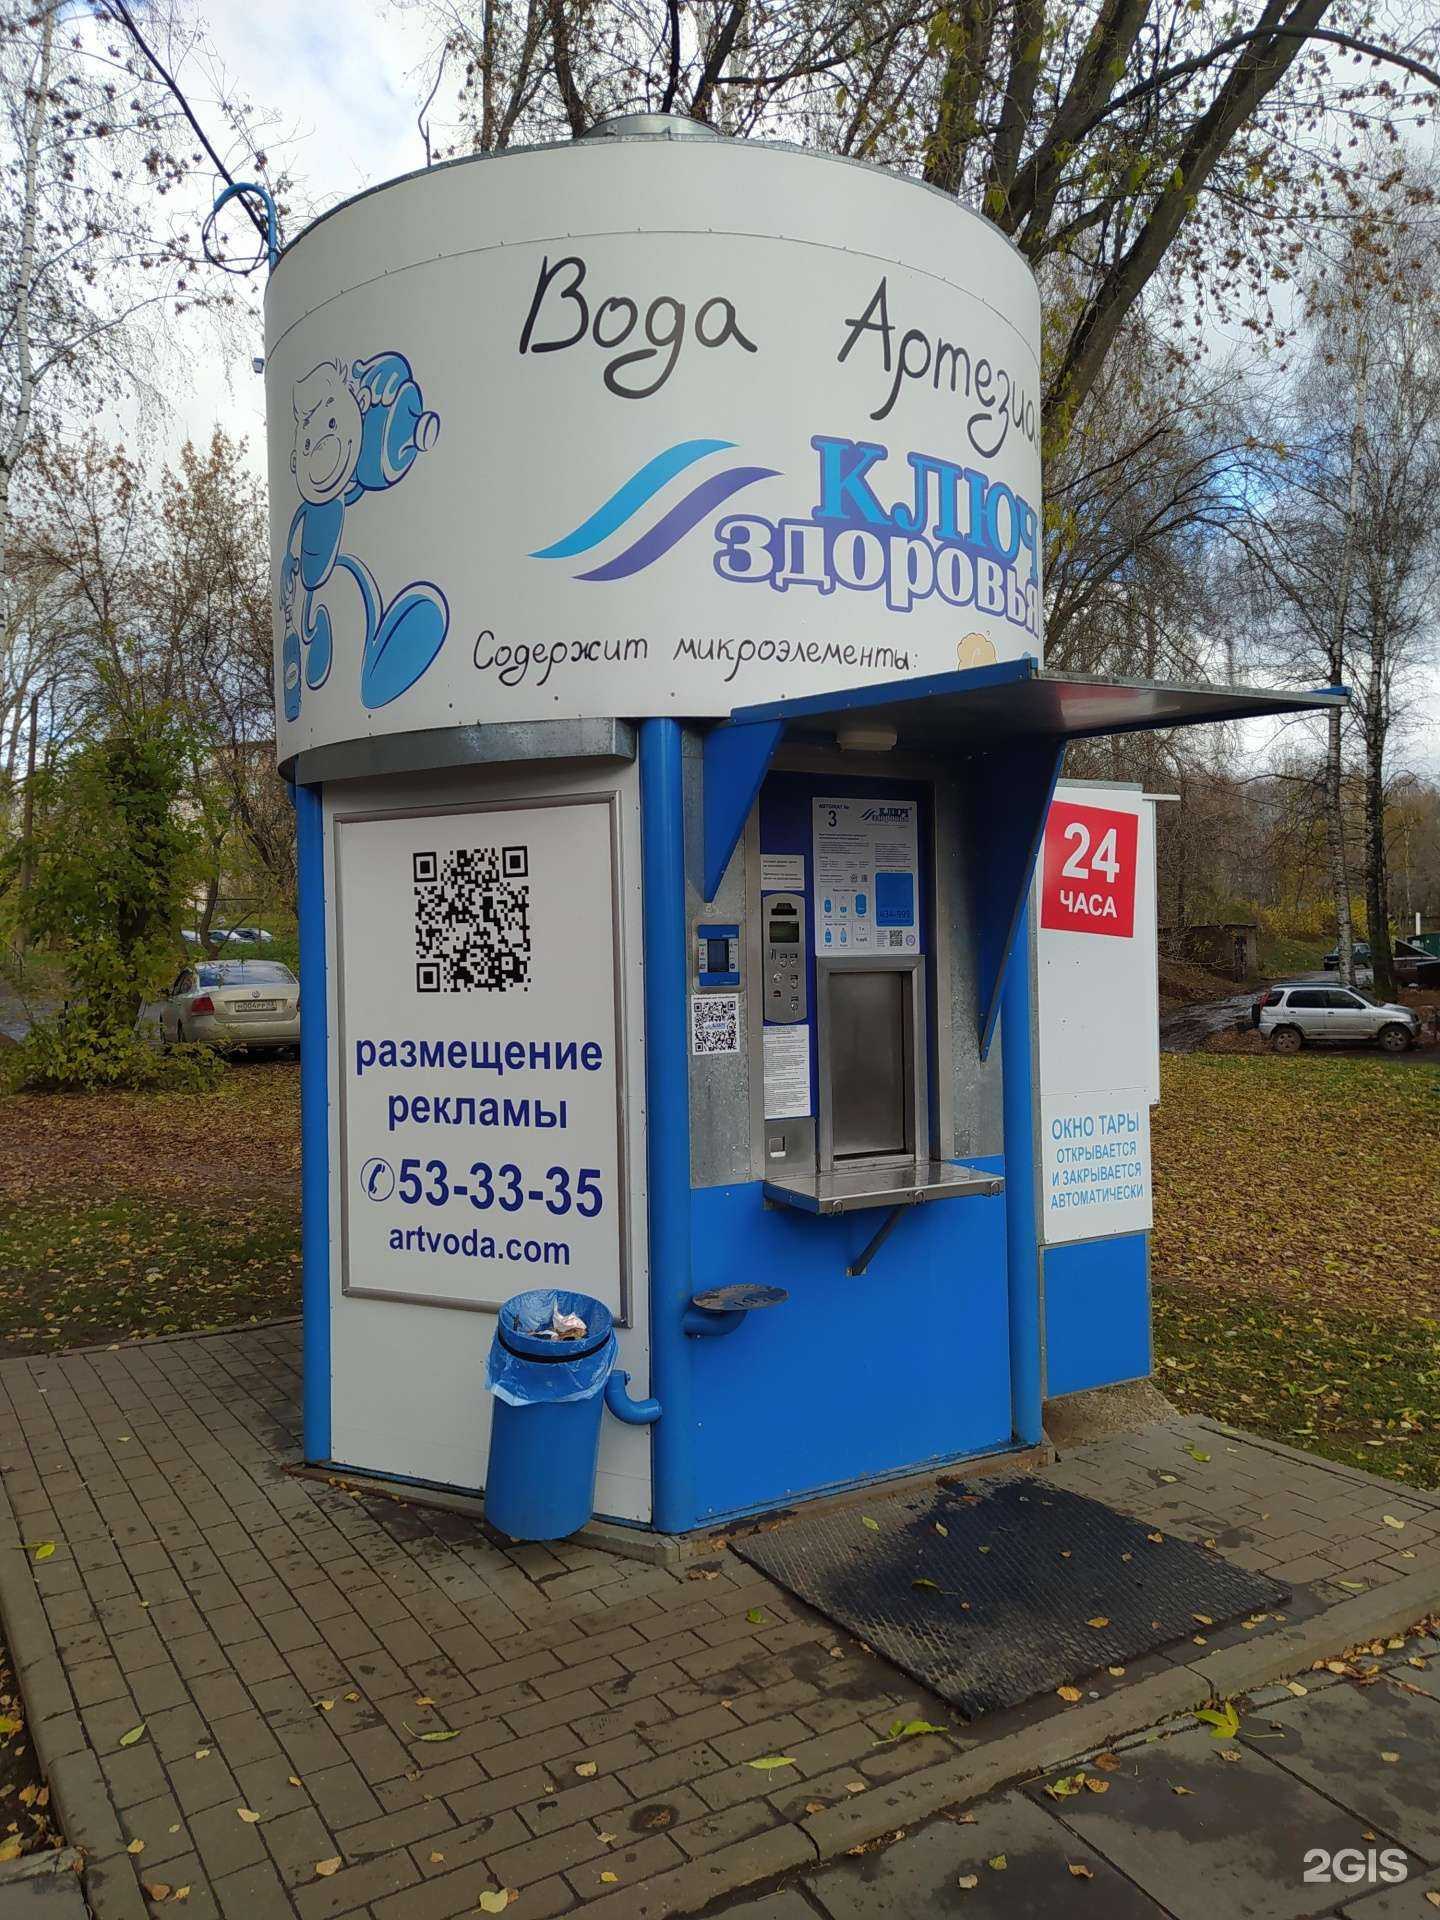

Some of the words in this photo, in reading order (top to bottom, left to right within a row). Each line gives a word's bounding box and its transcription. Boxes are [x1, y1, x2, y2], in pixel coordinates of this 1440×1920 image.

[519, 256, 758, 398] Вода
[473, 630, 648, 686] Содержит
[673, 637, 918, 682] микроэлементы:
[827, 810, 838, 828] 3
[1061, 821, 1121, 884] 24
[1059, 889, 1118, 918] ЧАСА
[355, 1038, 603, 1077] размещение
[388, 1094, 568, 1132] рекламы
[1051, 1116, 1095, 1140] ОКНО
[1099, 1112, 1140, 1135] ТАРЫ
[1056, 1141, 1137, 1163] ОТКРЫВАЕТСЯ
[398, 1157, 604, 1218] 53-33-35
[1052, 1171, 1060, 1186] И
[1062, 1162, 1142, 1186] ЗАКРЫВАЕТСЯ
[1051, 1184, 1144, 1209] АВТОМАТИЧЕСКИ
[388, 1225, 571, 1266] artvoda.com
